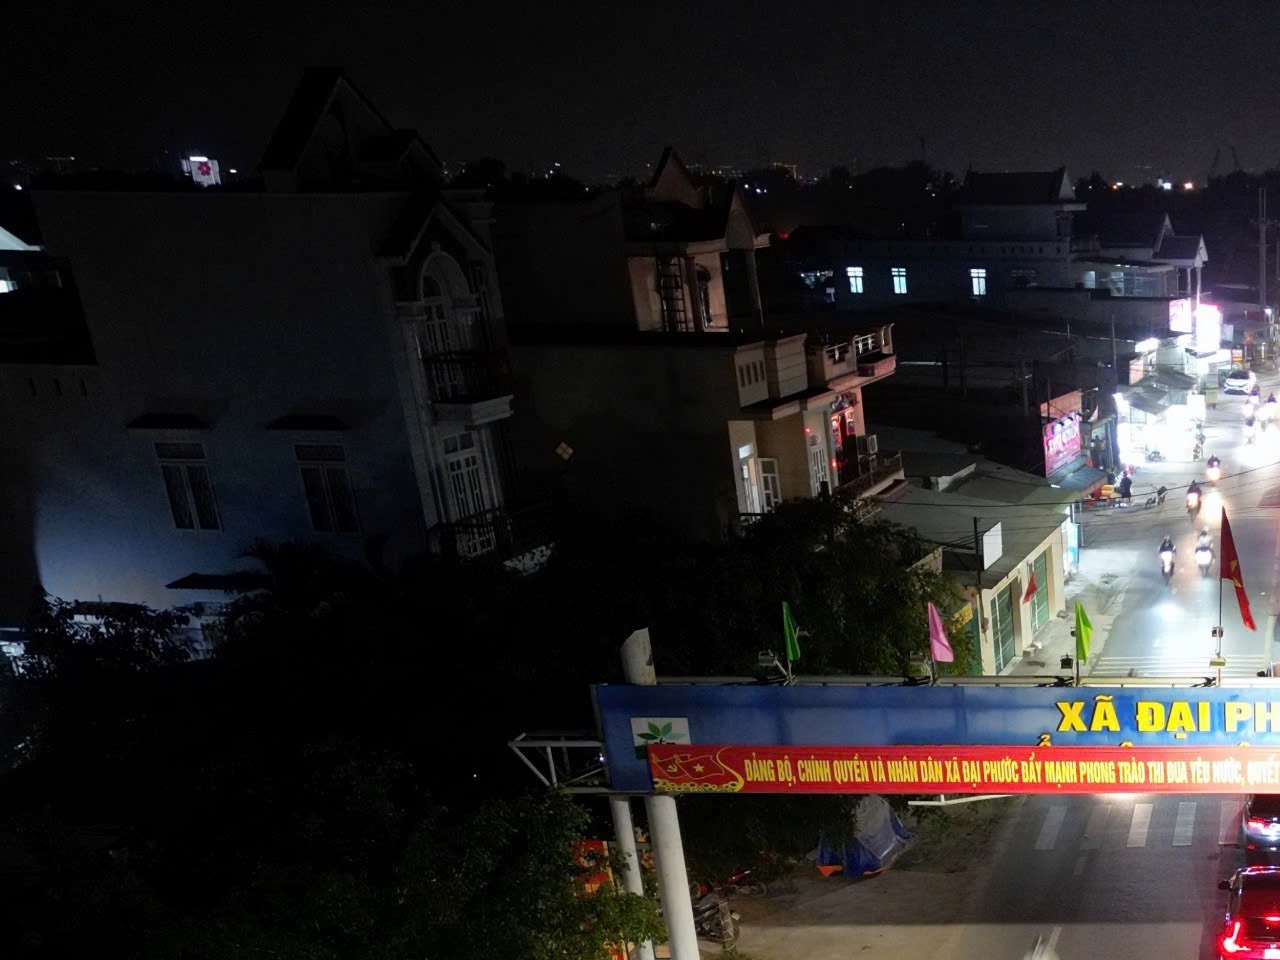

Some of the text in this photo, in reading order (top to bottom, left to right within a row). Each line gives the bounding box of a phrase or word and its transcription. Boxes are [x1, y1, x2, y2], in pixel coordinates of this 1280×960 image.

[1056, 695, 1121, 732] XÃ
[1136, 700, 1211, 739] ĐẠI
[744, 752, 776, 782] ĐẢNG
[798, 755, 832, 782] CHÍNH
[833, 753, 868, 784] QUYỀN
[870, 756, 886, 783] VÀ
[887, 755, 918, 783] NHÂN
[921, 756, 943, 783] DÂN
[946, 756, 961, 783] XÃ
[962, 760, 980, 788] ĐẠI
[983, 756, 1019, 783] PHƯỚC
[1045, 761, 1077, 788] MẠNH
[1080, 760, 1116, 784] PHONG
[1118, 756, 1145, 784] TRÀO
[1147, 761, 1164, 784] THI
[1166, 761, 1187, 784] ĐUA
[1189, 756, 1210, 784] YÊU
